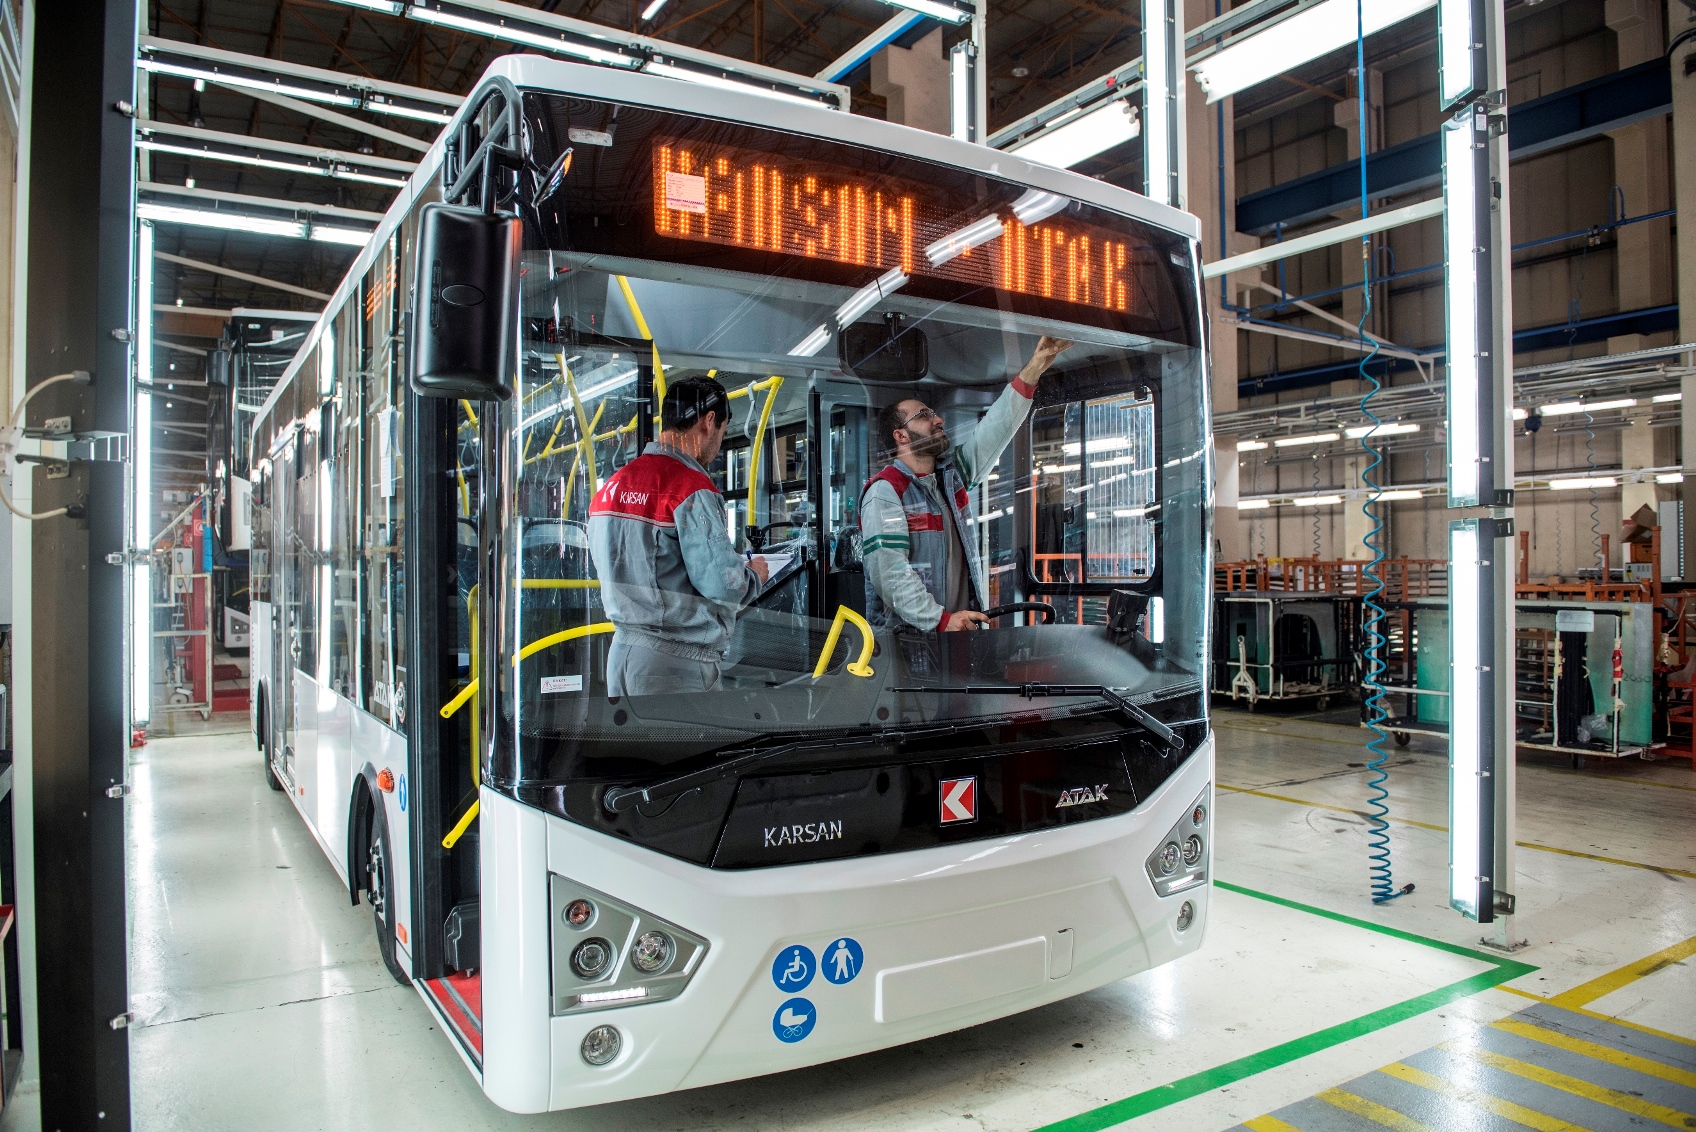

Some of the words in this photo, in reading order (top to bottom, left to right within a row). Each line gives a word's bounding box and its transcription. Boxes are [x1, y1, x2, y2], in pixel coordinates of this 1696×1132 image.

[619, 491, 649, 506] KARSAN
[1055, 783, 1109, 808] ATAK
[764, 819, 842, 848] KARSAN
